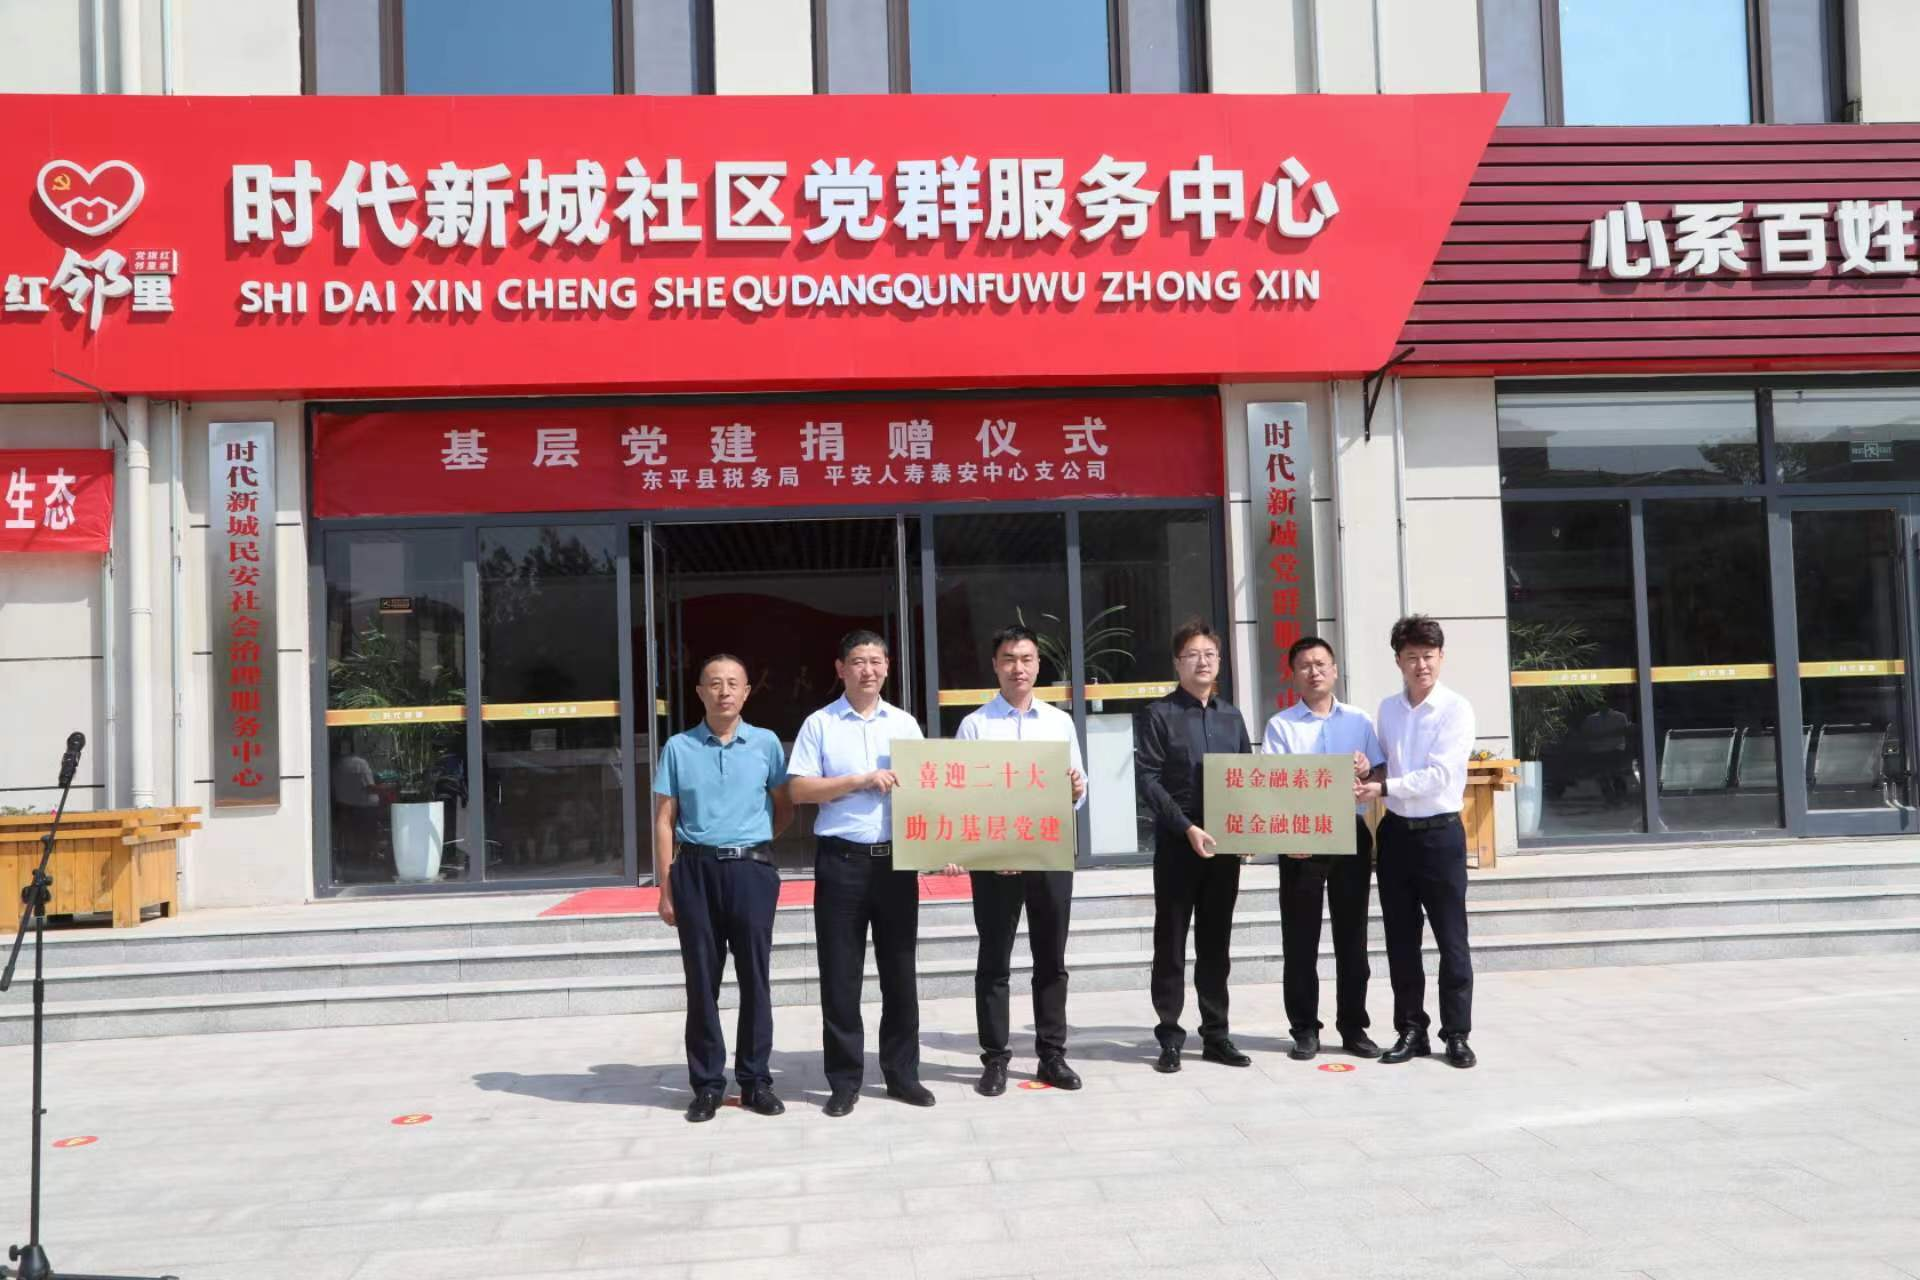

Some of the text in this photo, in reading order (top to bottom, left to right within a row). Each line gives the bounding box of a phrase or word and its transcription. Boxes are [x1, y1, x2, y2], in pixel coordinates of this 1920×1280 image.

[232, 154, 1340, 247] 时代新城社区党群服务中心
[1588, 200, 1919, 278] 心系百姓
[5, 247, 174, 332] 红邻里
[240, 280, 307, 313] SHI
[325, 279, 397, 313] DAI
[411, 279, 482, 313] XIN
[497, 277, 637, 311] CHENG
[1102, 270, 1241, 303] ZHONG
[1255, 269, 1320, 301] XIN
[441, 416, 1109, 471] 基层党建捐赠仪式
[5, 467, 76, 530] 生态
[642, 460, 1106, 490] 东平县税务局 平安人寿泰安中心支公司
[226, 440, 263, 787] 时代新城民安社会治理服务中心
[919, 761, 1047, 789] 喜迎二十大
[1225, 767, 1333, 789] 提金融素养
[904, 812, 1063, 842] 助力基层党建
[1225, 814, 1334, 835] 促金融健康
